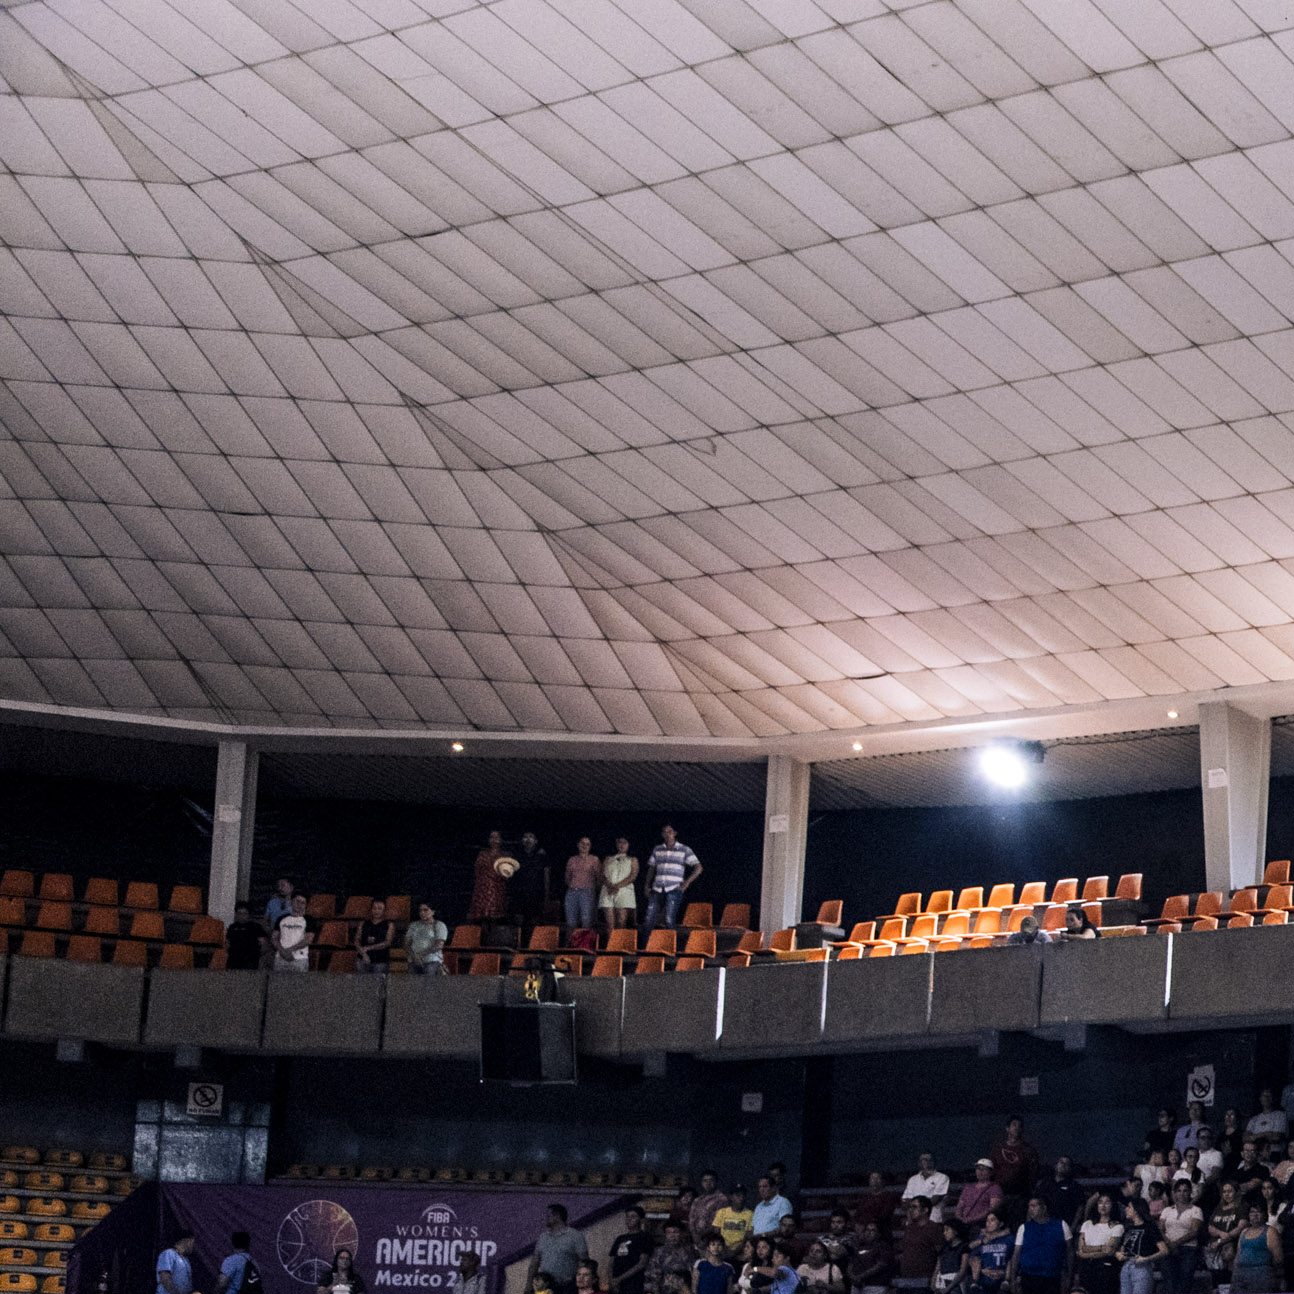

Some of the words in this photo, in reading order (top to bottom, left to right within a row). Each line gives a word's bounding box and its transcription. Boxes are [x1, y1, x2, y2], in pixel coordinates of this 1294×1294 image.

[427, 1212, 450, 1223] FIBA
[396, 1225, 478, 1238] WOMEN'S
[375, 1269, 442, 1287] Mexico
